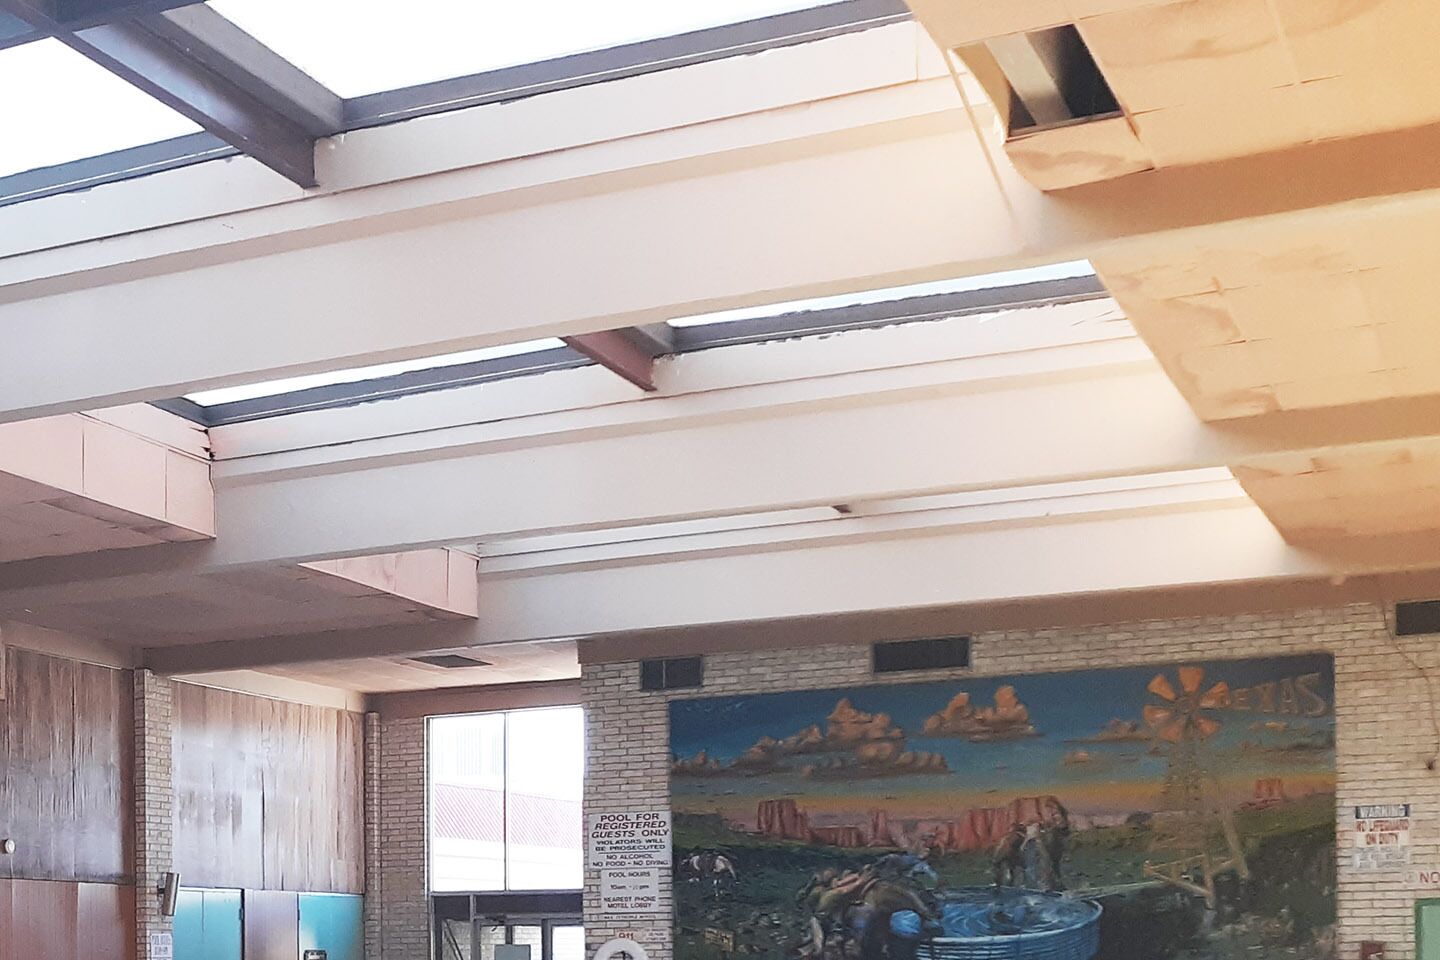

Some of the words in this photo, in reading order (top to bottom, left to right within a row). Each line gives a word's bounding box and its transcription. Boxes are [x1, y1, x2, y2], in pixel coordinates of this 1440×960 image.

[1230, 672, 1327, 718] EXAS
[1359, 806, 1406, 818] WARNING
[600, 814, 631, 822] POOL
[594, 820, 667, 830] REGISTERED
[591, 830, 636, 839] GUESTS
[641, 829, 670, 837] ONLY
